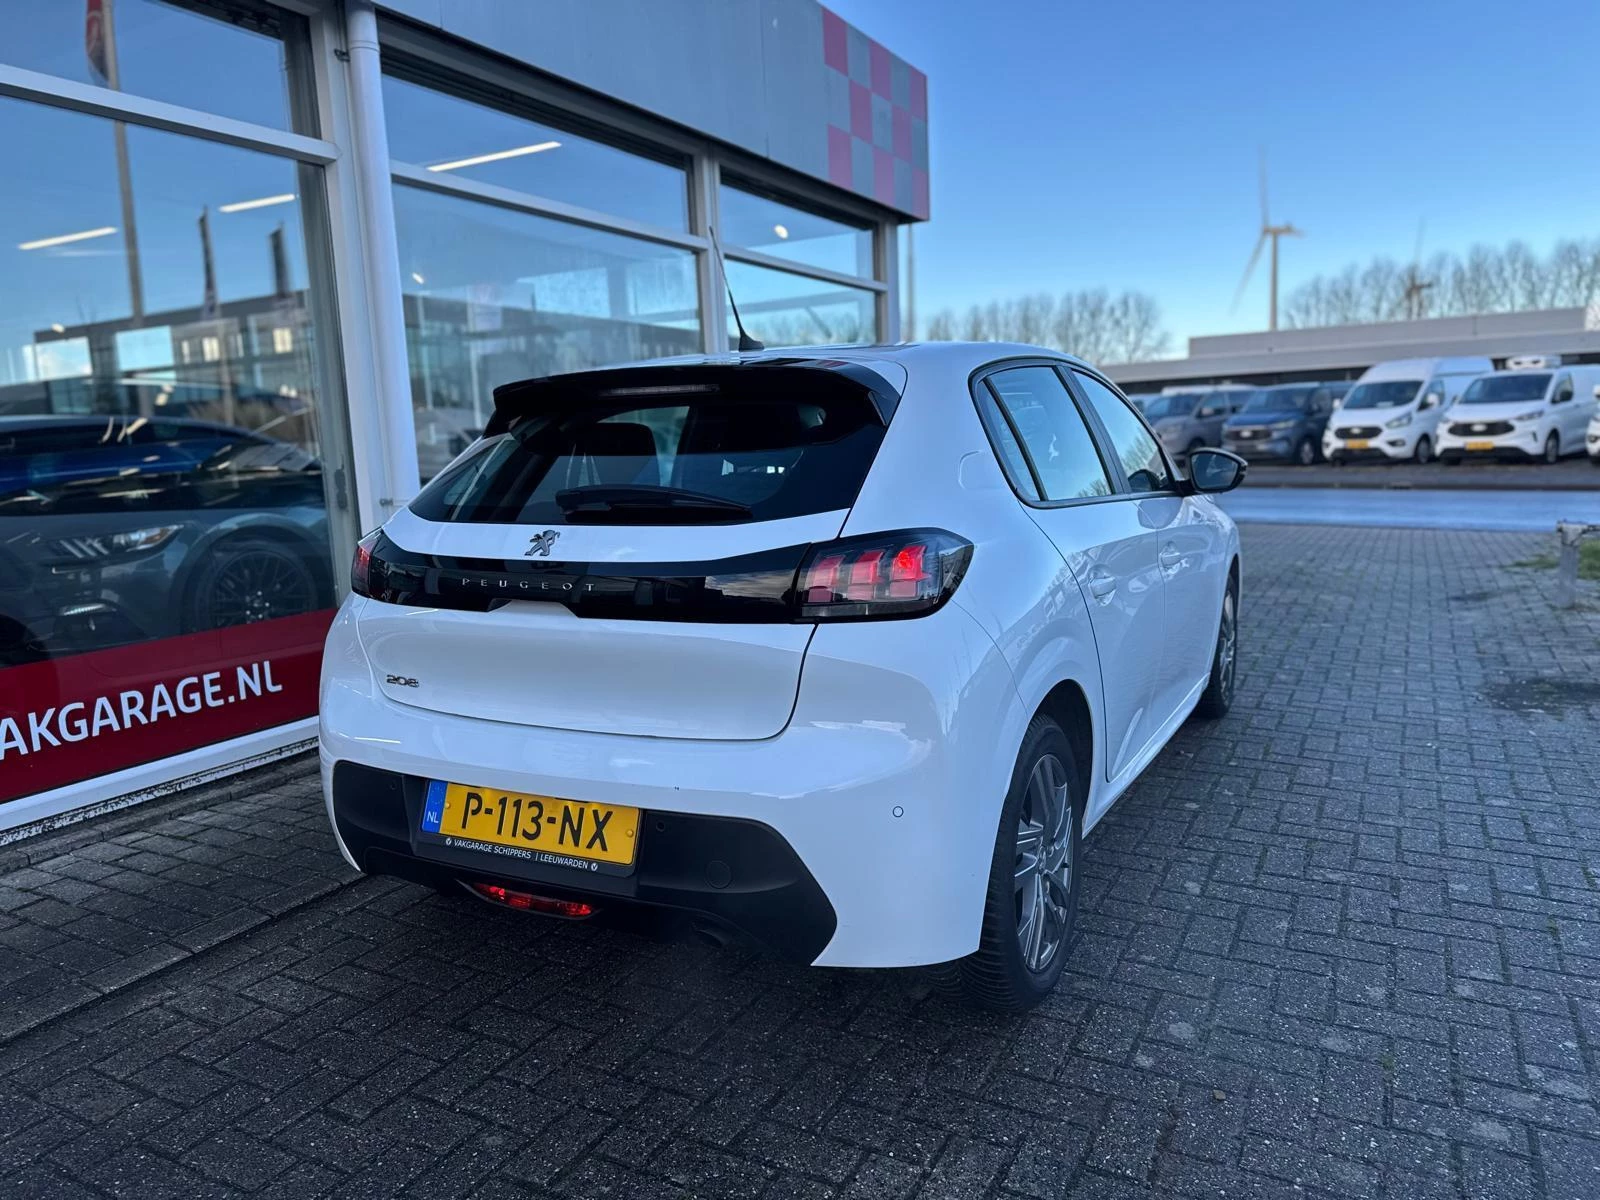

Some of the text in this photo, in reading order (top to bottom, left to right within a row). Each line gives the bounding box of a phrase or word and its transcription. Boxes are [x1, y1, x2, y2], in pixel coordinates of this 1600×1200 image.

[462, 577, 595, 592] PEUGEOT
[386, 674, 419, 688] 208
[426, 810, 439, 824] NL
[461, 792, 613, 852] P-113-NX
[454, 838, 589, 869] VAKGARAGE SCHIPPERS LEEUWARDEN
